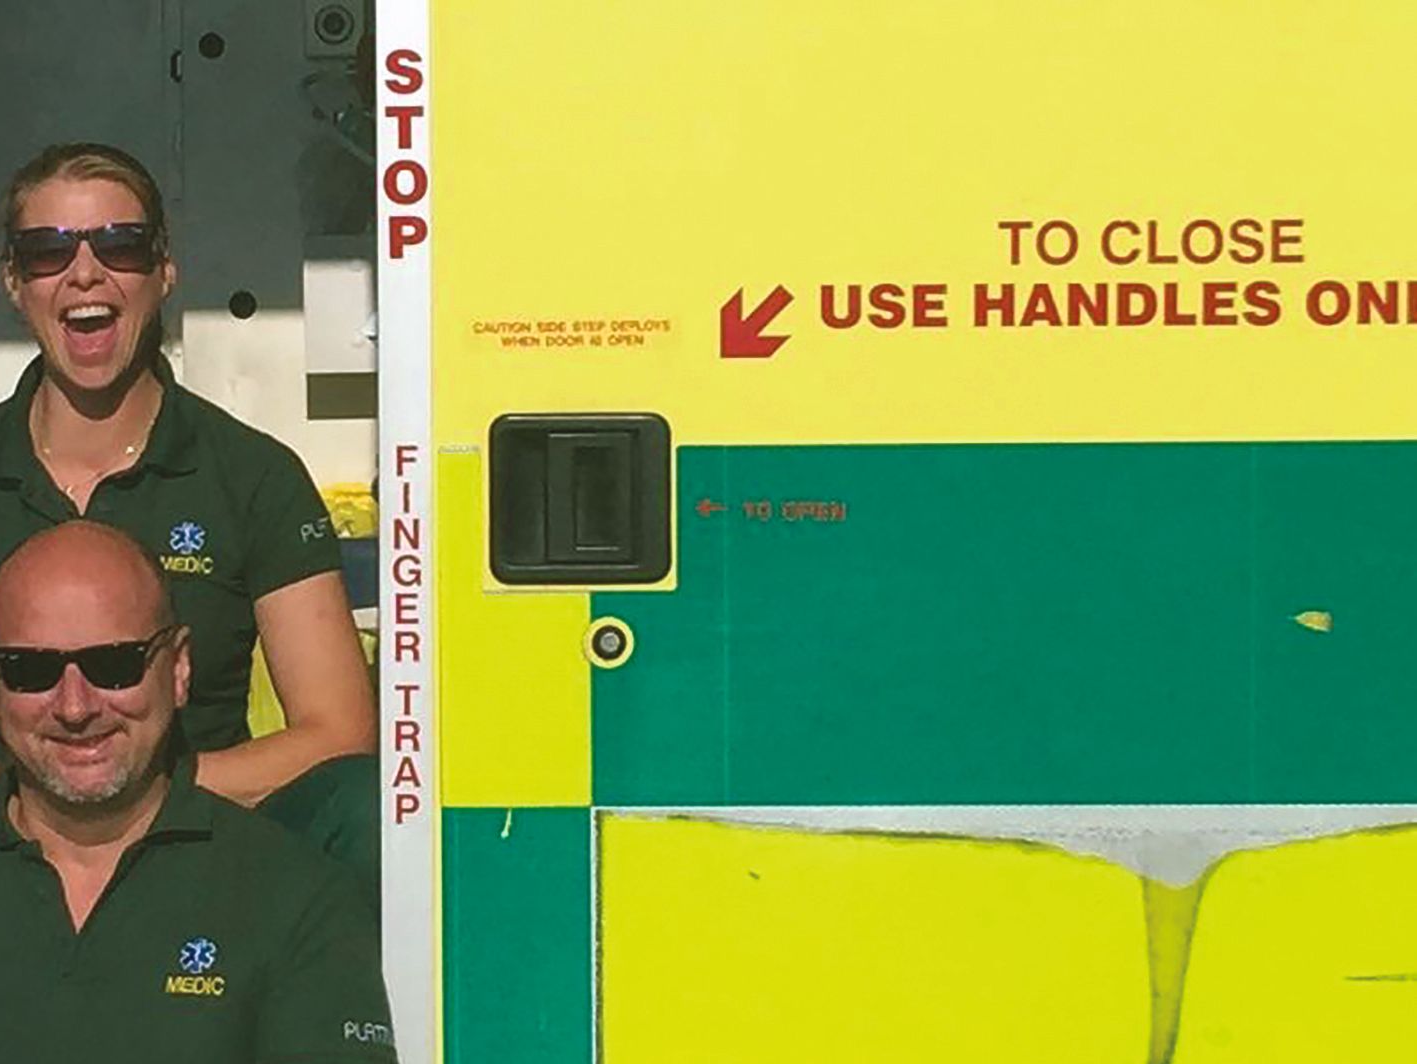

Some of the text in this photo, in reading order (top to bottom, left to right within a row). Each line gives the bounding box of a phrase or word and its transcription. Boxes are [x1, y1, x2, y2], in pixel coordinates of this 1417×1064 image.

[383, 49, 428, 259] STOP
[998, 219, 1305, 266] TO CLOSE
[820, 283, 948, 330] USE
[973, 281, 1281, 328] HANDLES
[472, 321, 531, 334] CAUTION
[572, 320, 605, 333] STEP
[500, 335, 540, 348] WHEN
[545, 334, 584, 347] DOOR
[607, 334, 644, 347] OPEN
[742, 500, 847, 523] TO OPEN
[159, 555, 214, 574] MEDIC
[392, 444, 422, 825] FINGER TRAP
[165, 976, 225, 996] MEDIC
